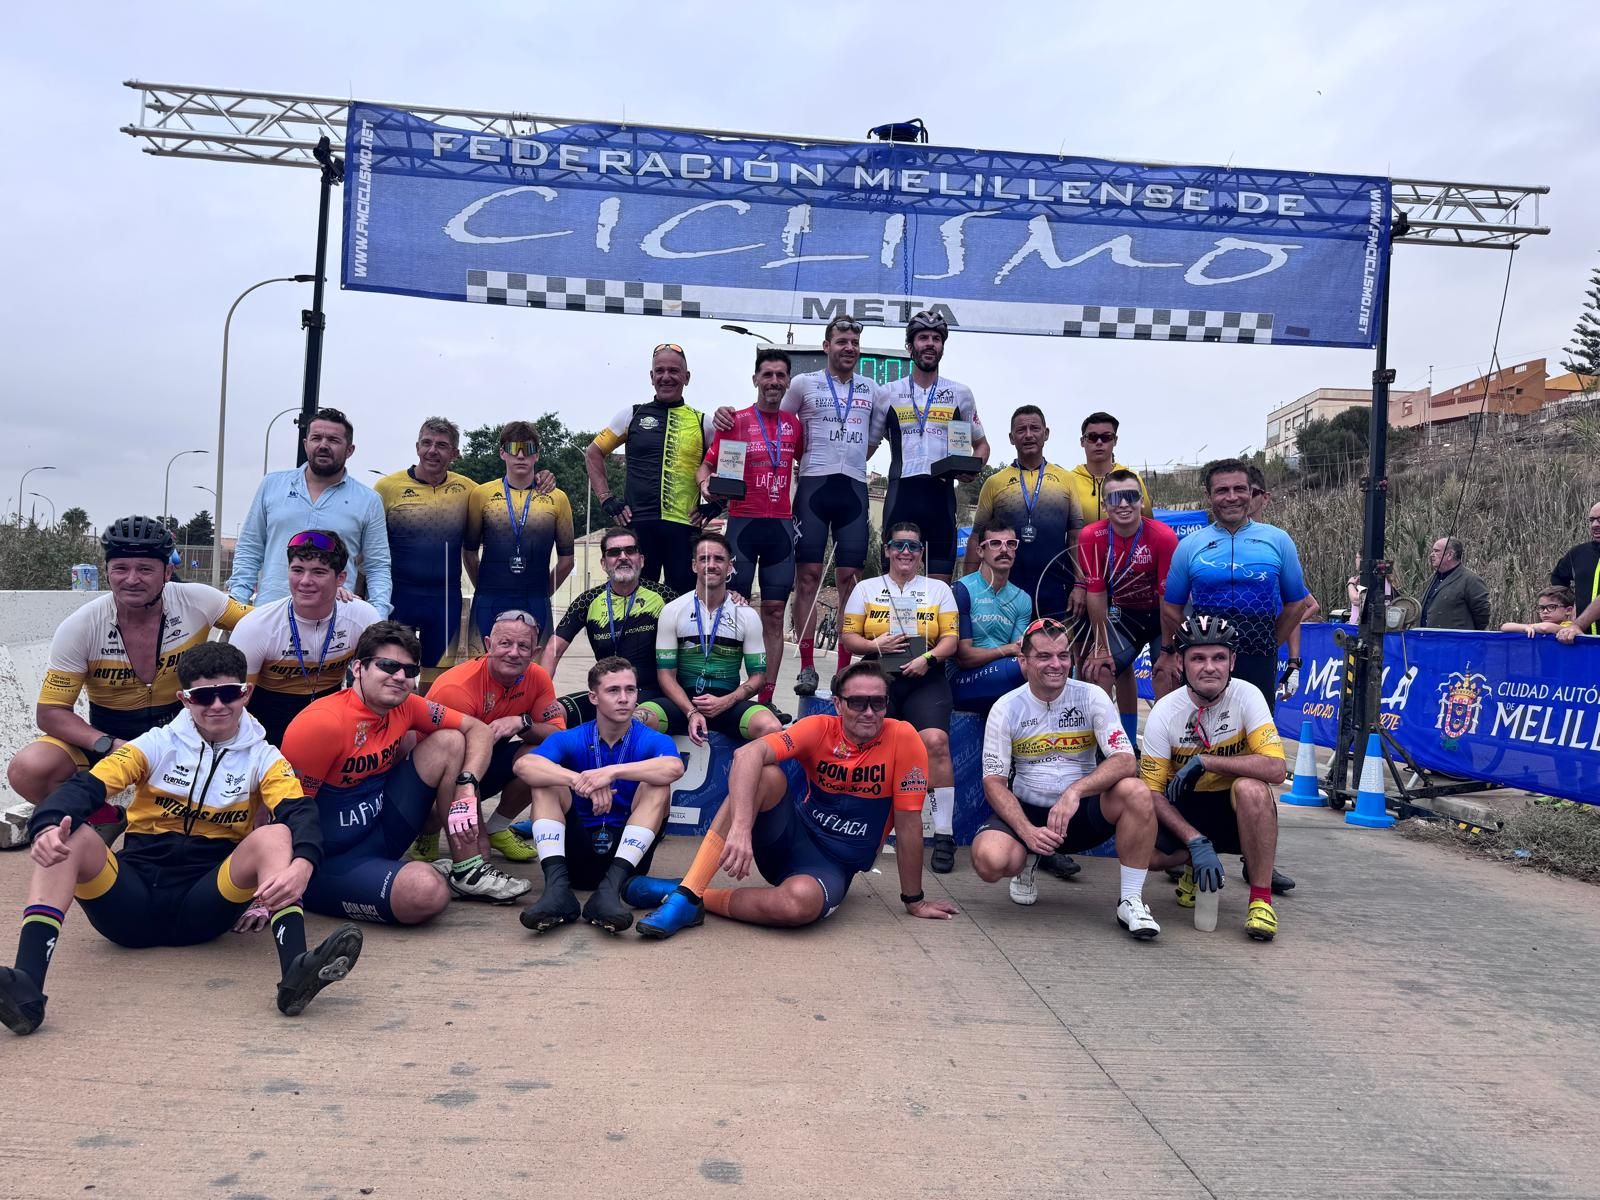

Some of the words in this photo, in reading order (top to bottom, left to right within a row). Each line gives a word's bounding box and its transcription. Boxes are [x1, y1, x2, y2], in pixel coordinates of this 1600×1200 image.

[433, 131, 823, 186] FEDERACIÓN
[854, 165, 1210, 211] MELILLENSE
[1237, 191, 1306, 216] DE
[441, 185, 1303, 286] CICLISMO
[802, 297, 960, 327] META
[1498, 682, 1549, 699] CIUDAD
[1302, 702, 1334, 719] CIUDAD
[1506, 702, 1515, 711] DE
[341, 752, 379, 775] DON
[816, 760, 848, 782] DON
[852, 764, 885, 783] BICI
[163, 774, 190, 788] Eventos
[210, 808, 248, 824] BIKES
